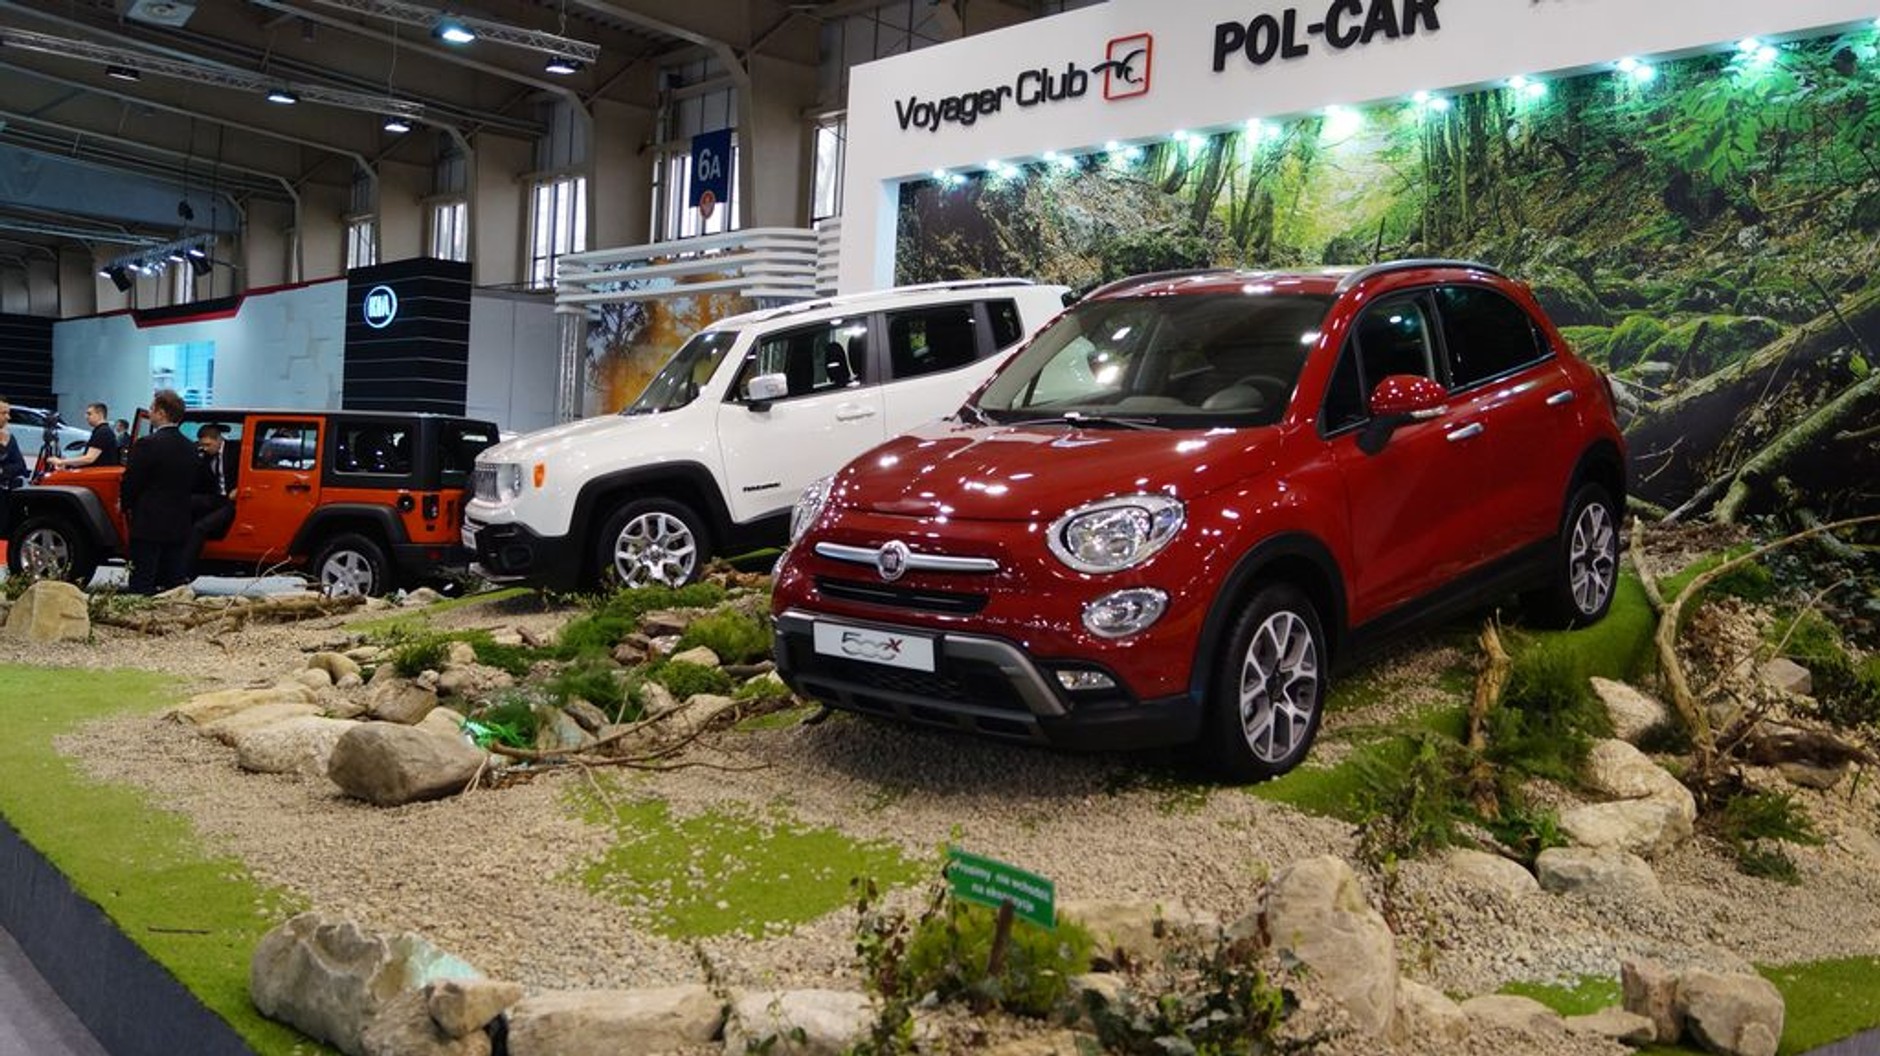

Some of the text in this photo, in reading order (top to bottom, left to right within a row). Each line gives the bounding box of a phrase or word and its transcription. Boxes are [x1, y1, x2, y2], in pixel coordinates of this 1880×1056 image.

[1213, 0, 1441, 72] POL-CAR
[895, 62, 1089, 132] Voyager Club
[698, 148, 721, 181] 6A
[368, 294, 391, 317] KIA
